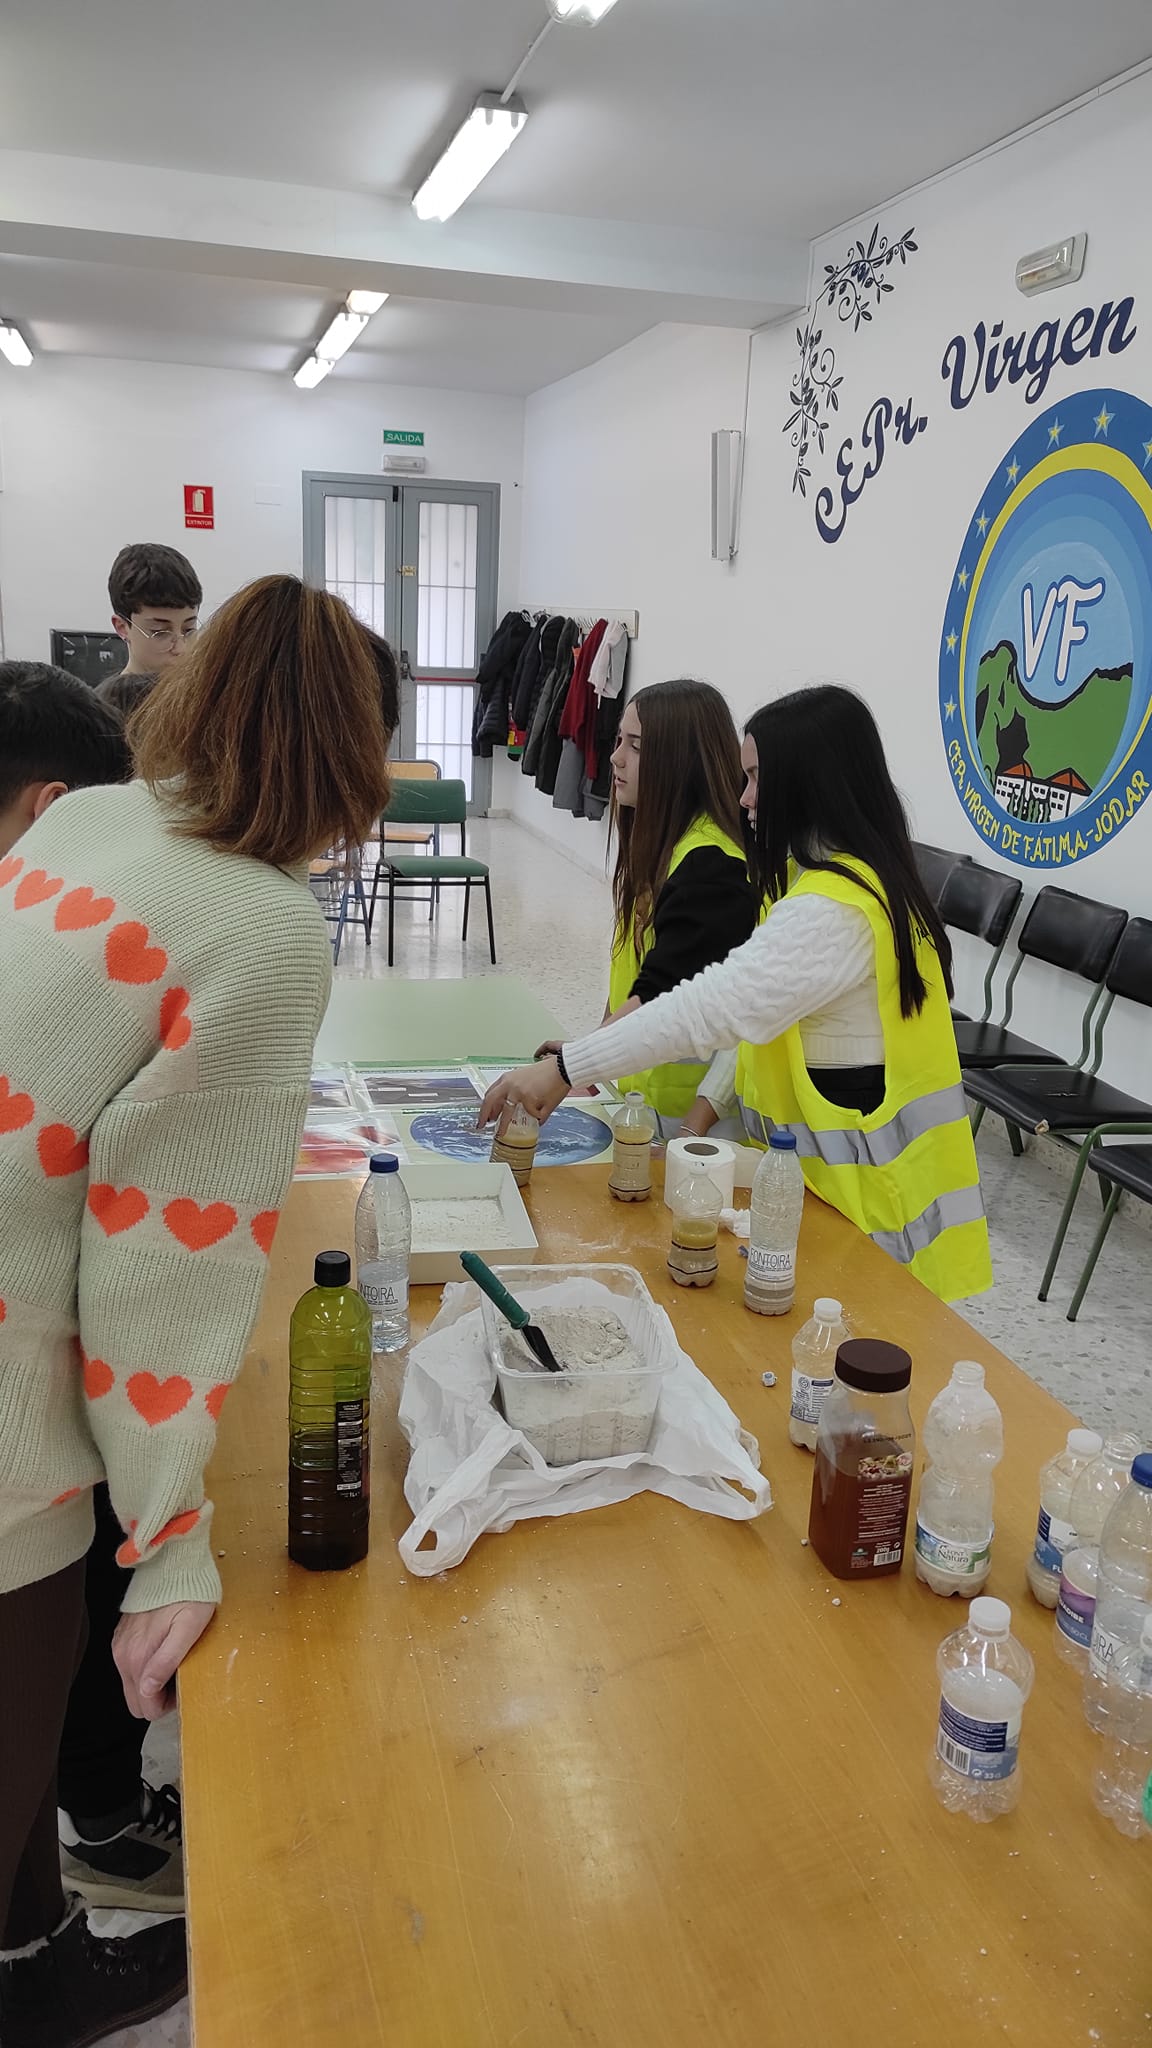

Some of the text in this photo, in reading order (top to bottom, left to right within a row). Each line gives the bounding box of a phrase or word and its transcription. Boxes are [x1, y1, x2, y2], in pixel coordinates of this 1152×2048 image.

[941, 297, 1137, 409] Virgen
[386, 432, 422, 444] SALIDA
[1022, 575, 1105, 686] VF
[963, 781, 1000, 841] VIRGEN
[1001, 824, 1022, 855] DE
[750, 1247, 791, 1270] FONTOIRA
